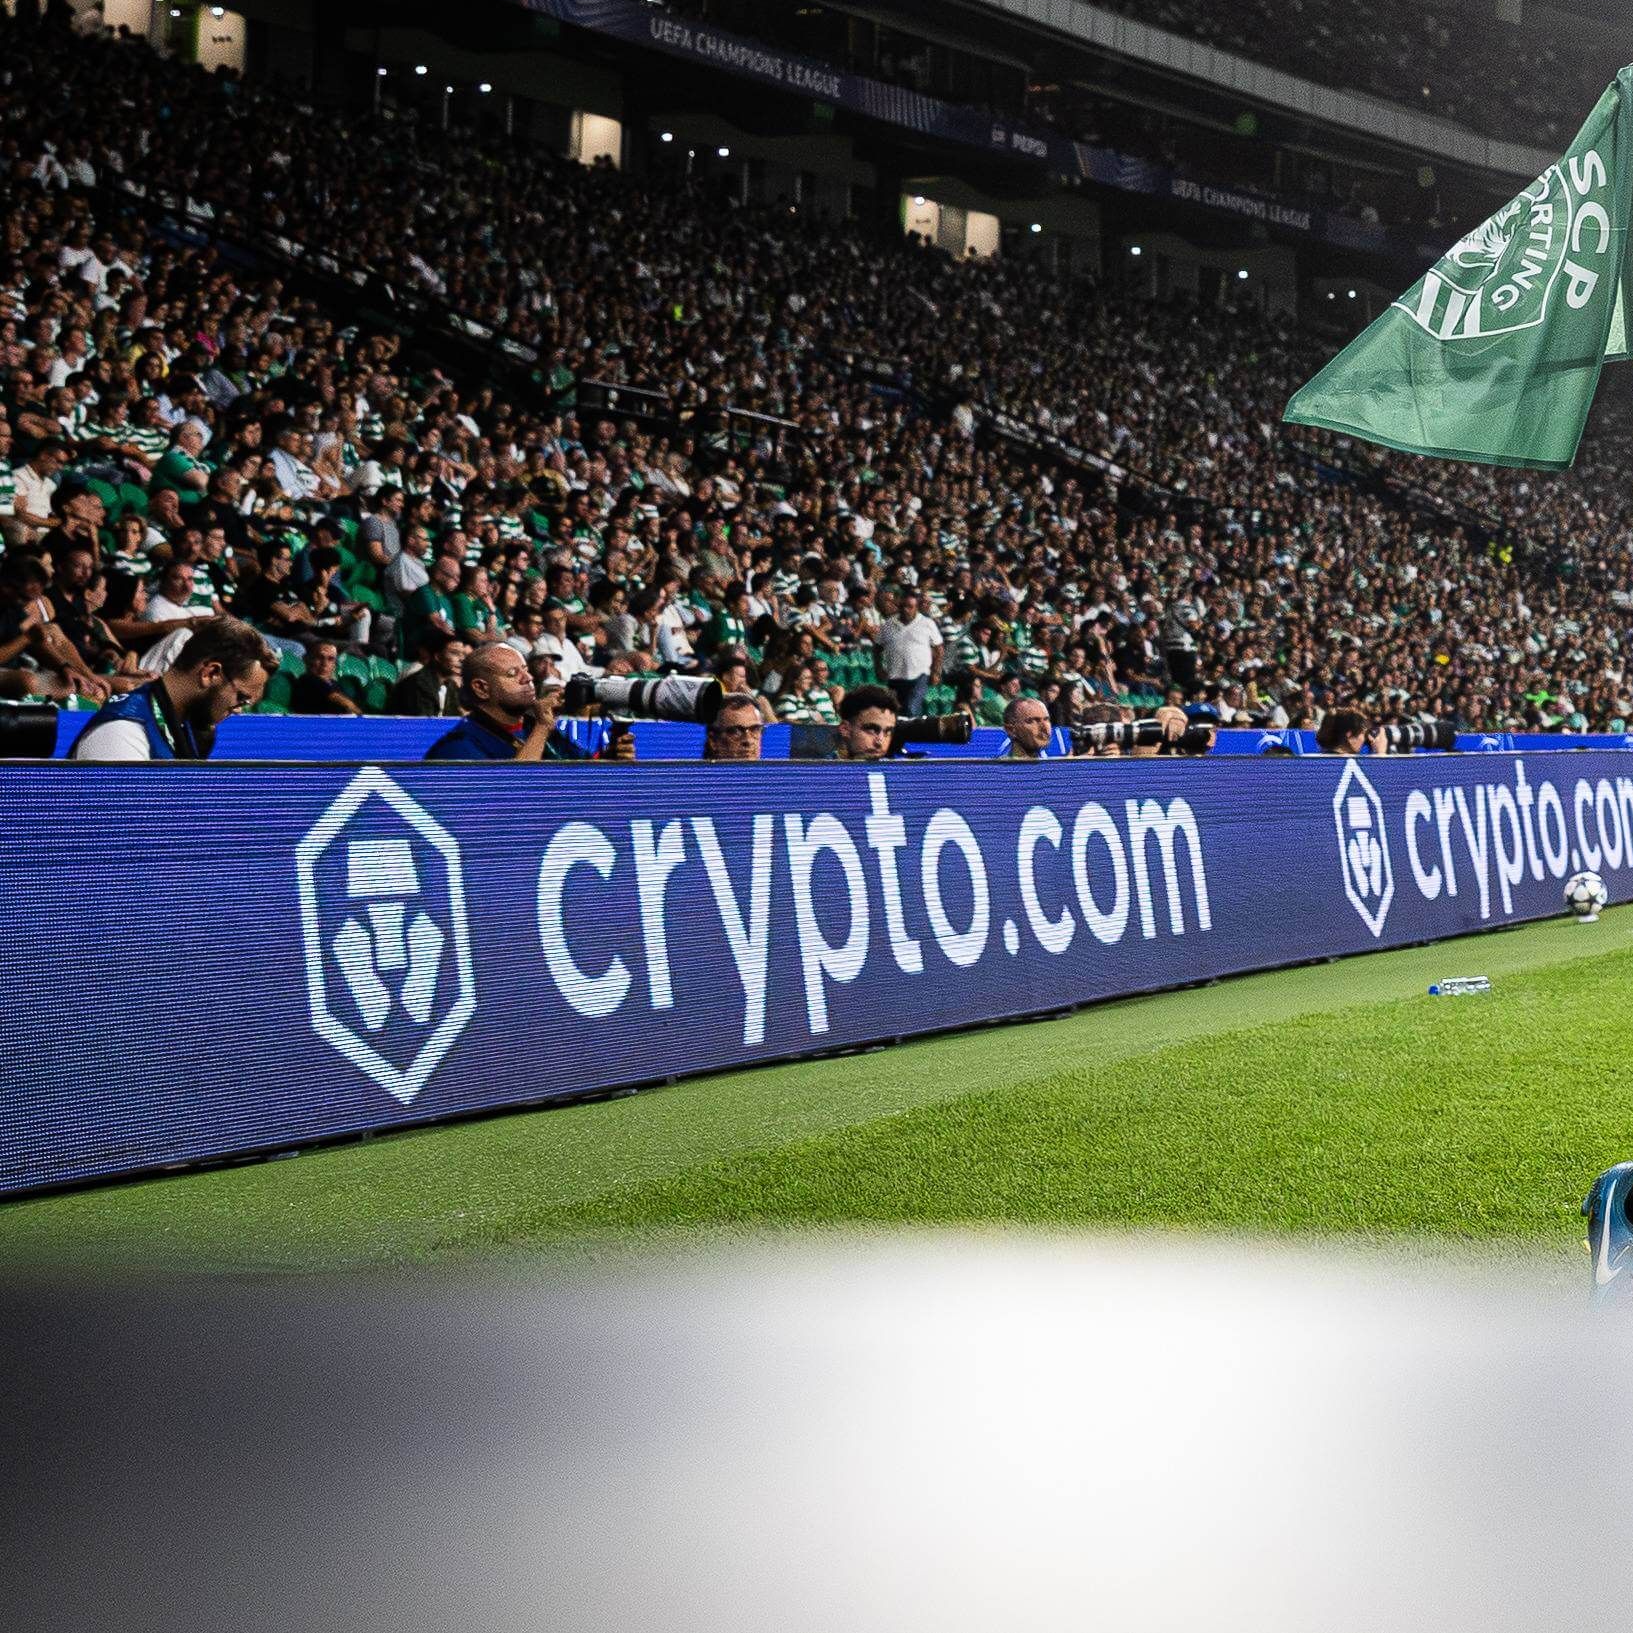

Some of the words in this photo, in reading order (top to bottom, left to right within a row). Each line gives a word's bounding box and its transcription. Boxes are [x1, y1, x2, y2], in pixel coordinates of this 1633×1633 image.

[649, 16, 692, 49] UEFA
[695, 31, 782, 80] CHAMPIONS
[786, 61, 841, 99] LEAGUE
[1564, 149, 1611, 310] SCP
[537, 771, 1213, 1045] crypto.com
